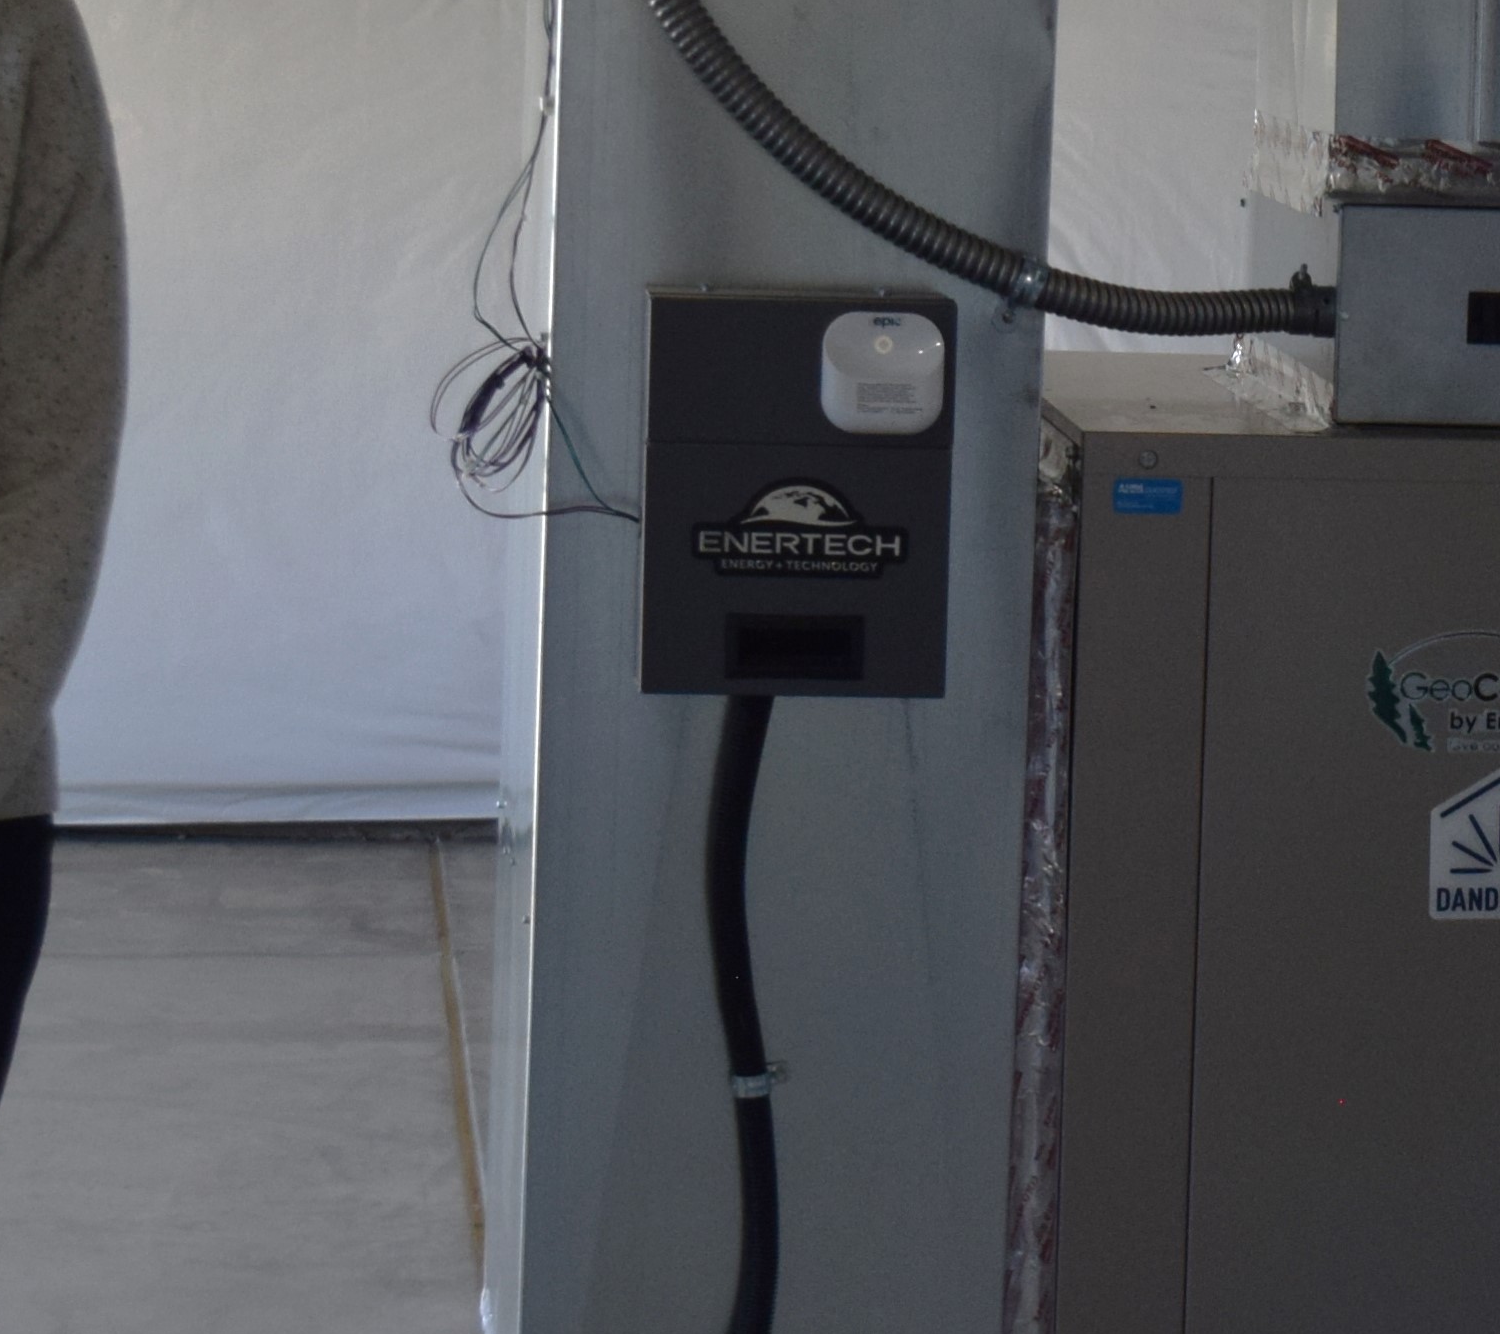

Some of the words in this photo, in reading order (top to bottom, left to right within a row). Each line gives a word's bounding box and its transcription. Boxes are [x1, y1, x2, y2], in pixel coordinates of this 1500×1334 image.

[698, 530, 901, 557] ENERTECH
[721, 559, 773, 570] ENERGY
[786, 560, 878, 572] TECHNOLOGY
[1450, 712, 1477, 734] by
